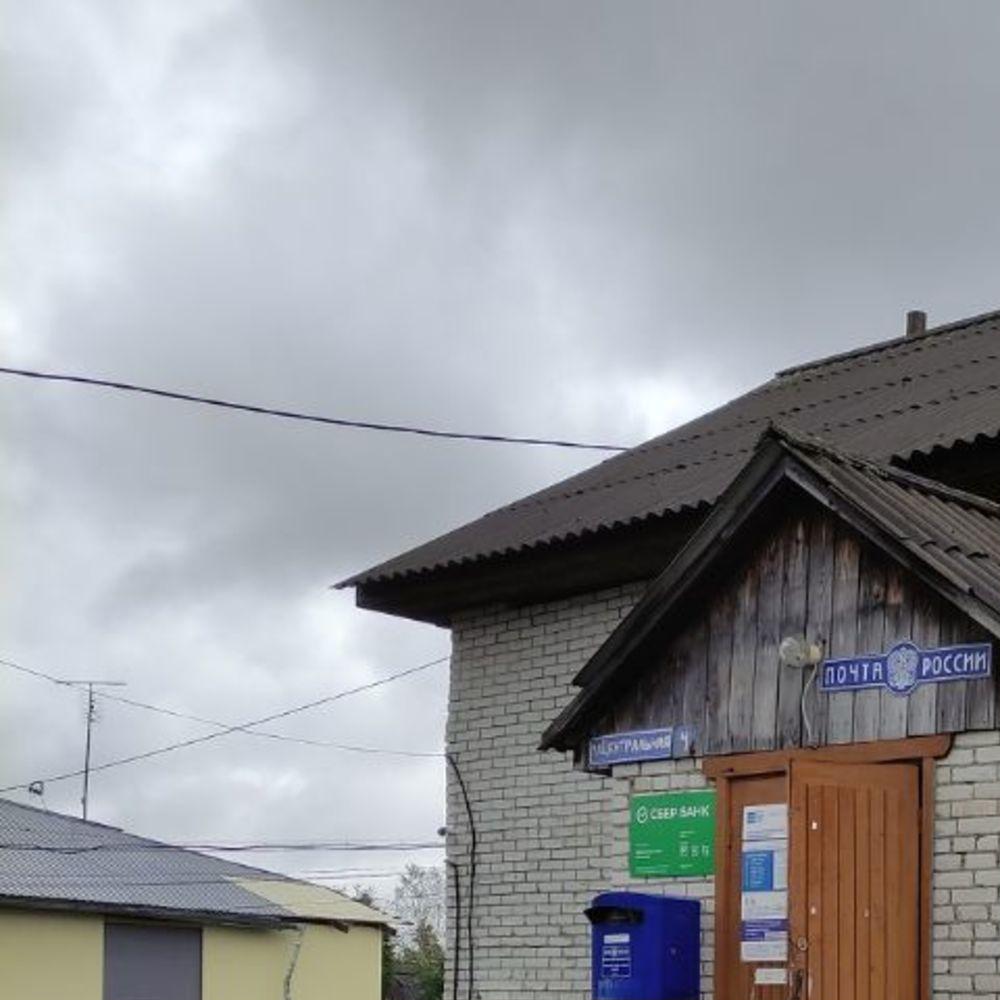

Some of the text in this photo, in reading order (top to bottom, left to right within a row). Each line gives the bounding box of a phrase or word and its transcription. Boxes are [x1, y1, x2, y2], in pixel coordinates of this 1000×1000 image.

[825, 652, 986, 684] ПОЧТА РОССИИ
[679, 805, 710, 818] БАНК
